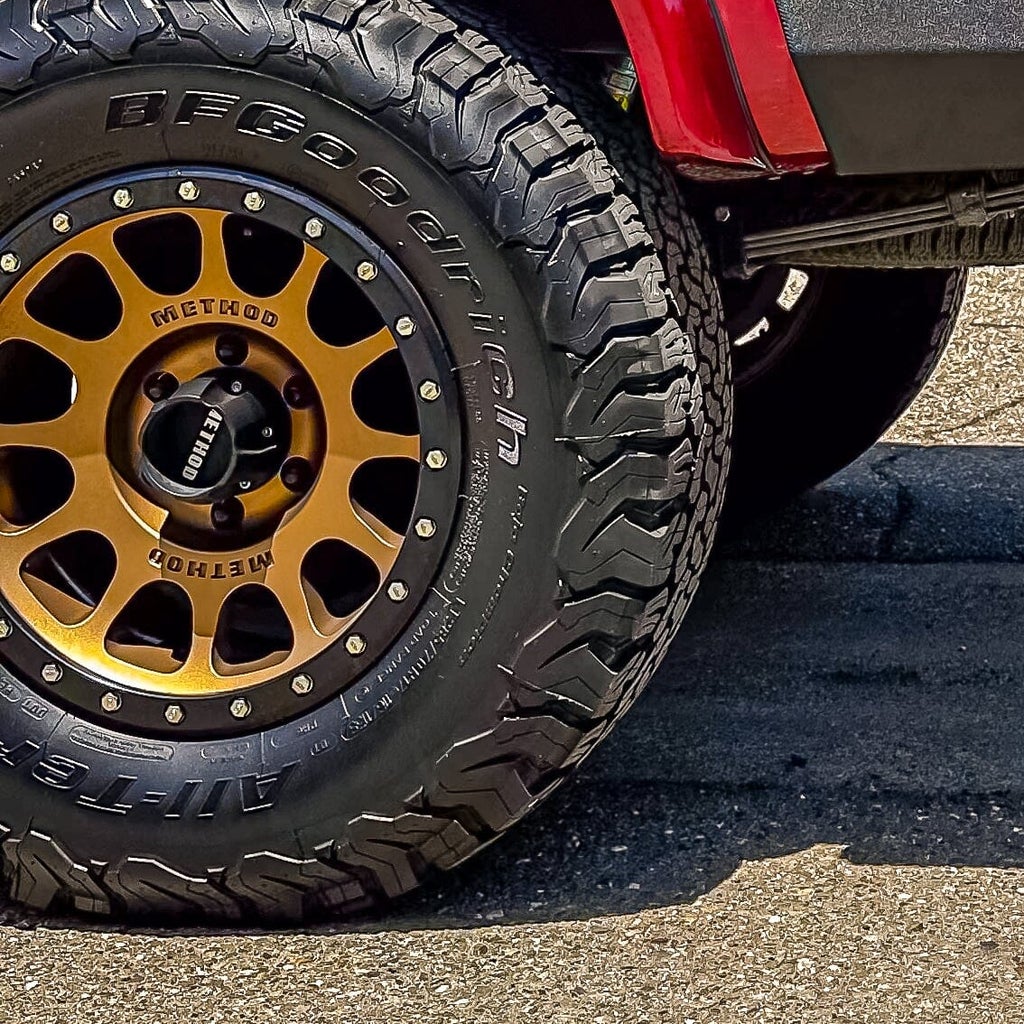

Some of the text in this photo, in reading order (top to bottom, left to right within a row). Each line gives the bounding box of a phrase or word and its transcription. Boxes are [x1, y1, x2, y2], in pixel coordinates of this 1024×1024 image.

[104, 88, 529, 466] BFGoodrich
[150, 297, 279, 328] METHOD
[148, 547, 275, 580] METHOD
